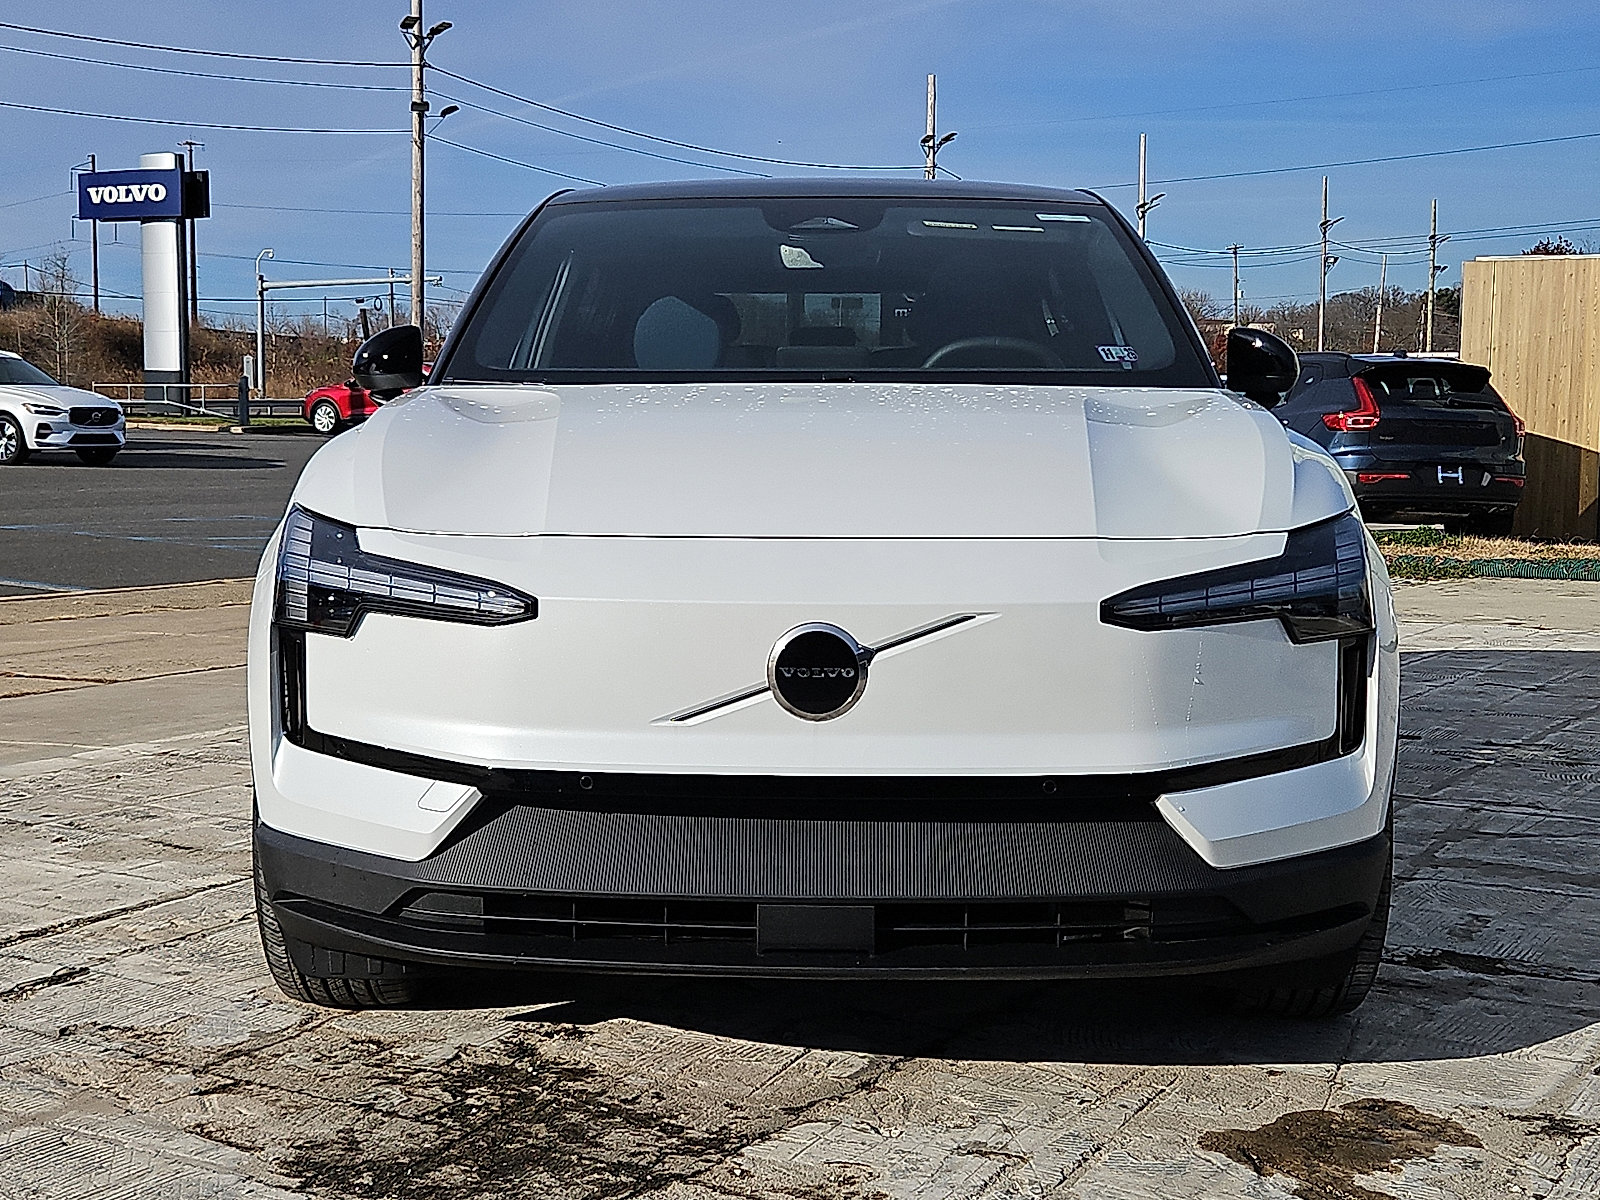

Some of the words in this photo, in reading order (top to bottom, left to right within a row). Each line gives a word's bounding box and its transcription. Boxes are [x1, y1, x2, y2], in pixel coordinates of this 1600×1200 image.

[86, 183, 167, 204] VOLVO
[1100, 347, 1116, 360] 11
[779, 667, 855, 678] VOLVO
